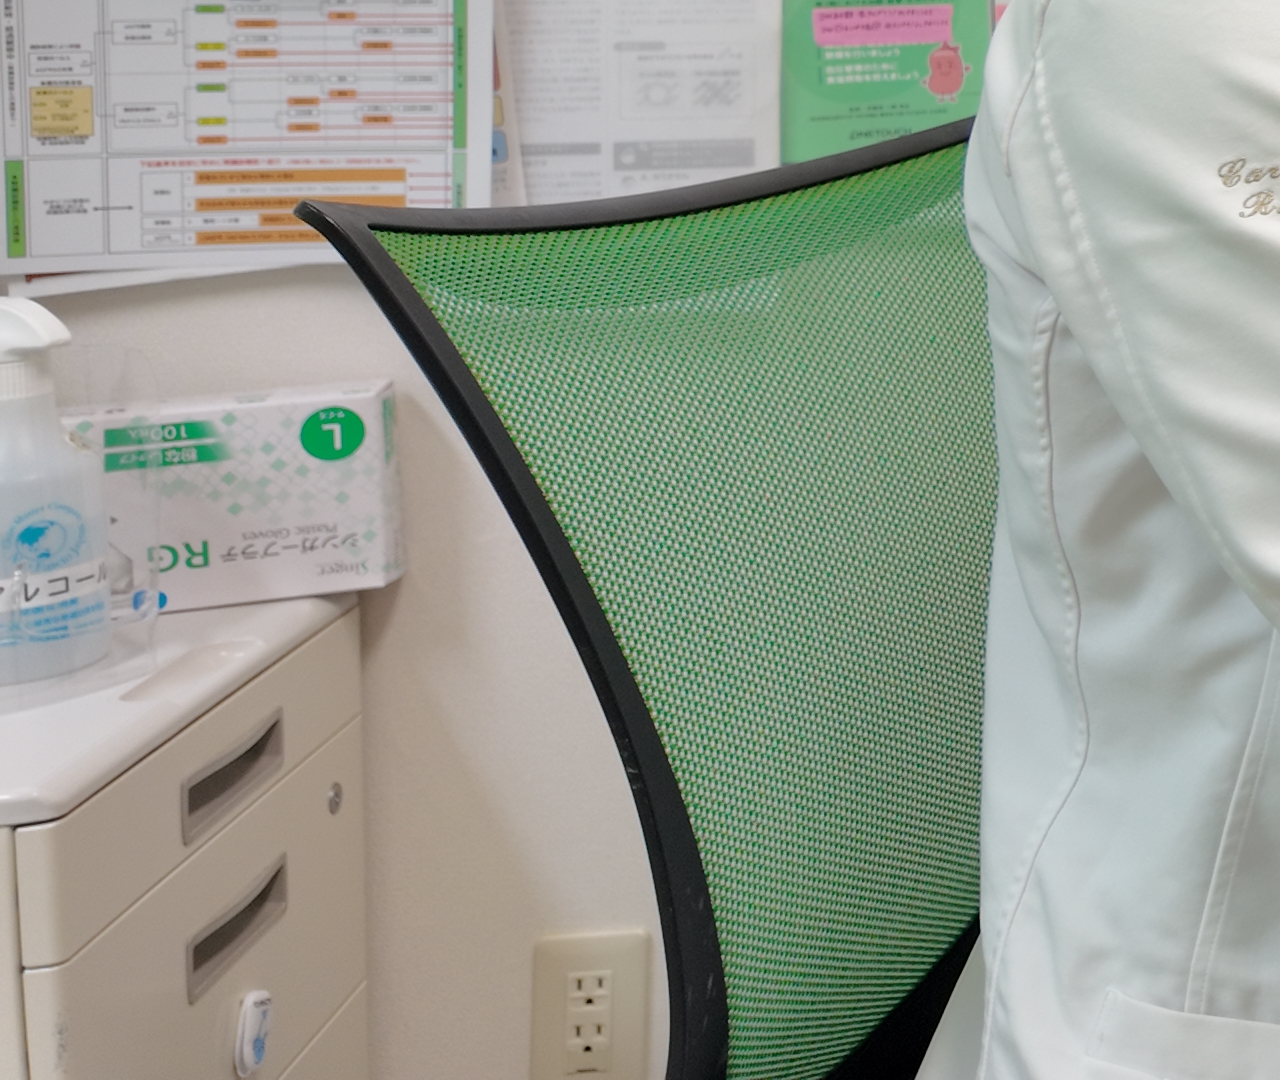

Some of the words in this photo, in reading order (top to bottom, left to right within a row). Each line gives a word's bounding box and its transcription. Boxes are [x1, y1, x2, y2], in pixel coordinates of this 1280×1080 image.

[321, 422, 342, 451] L
[146, 540, 210, 574] RG
[219, 532, 359, 563] シンガープラテ
